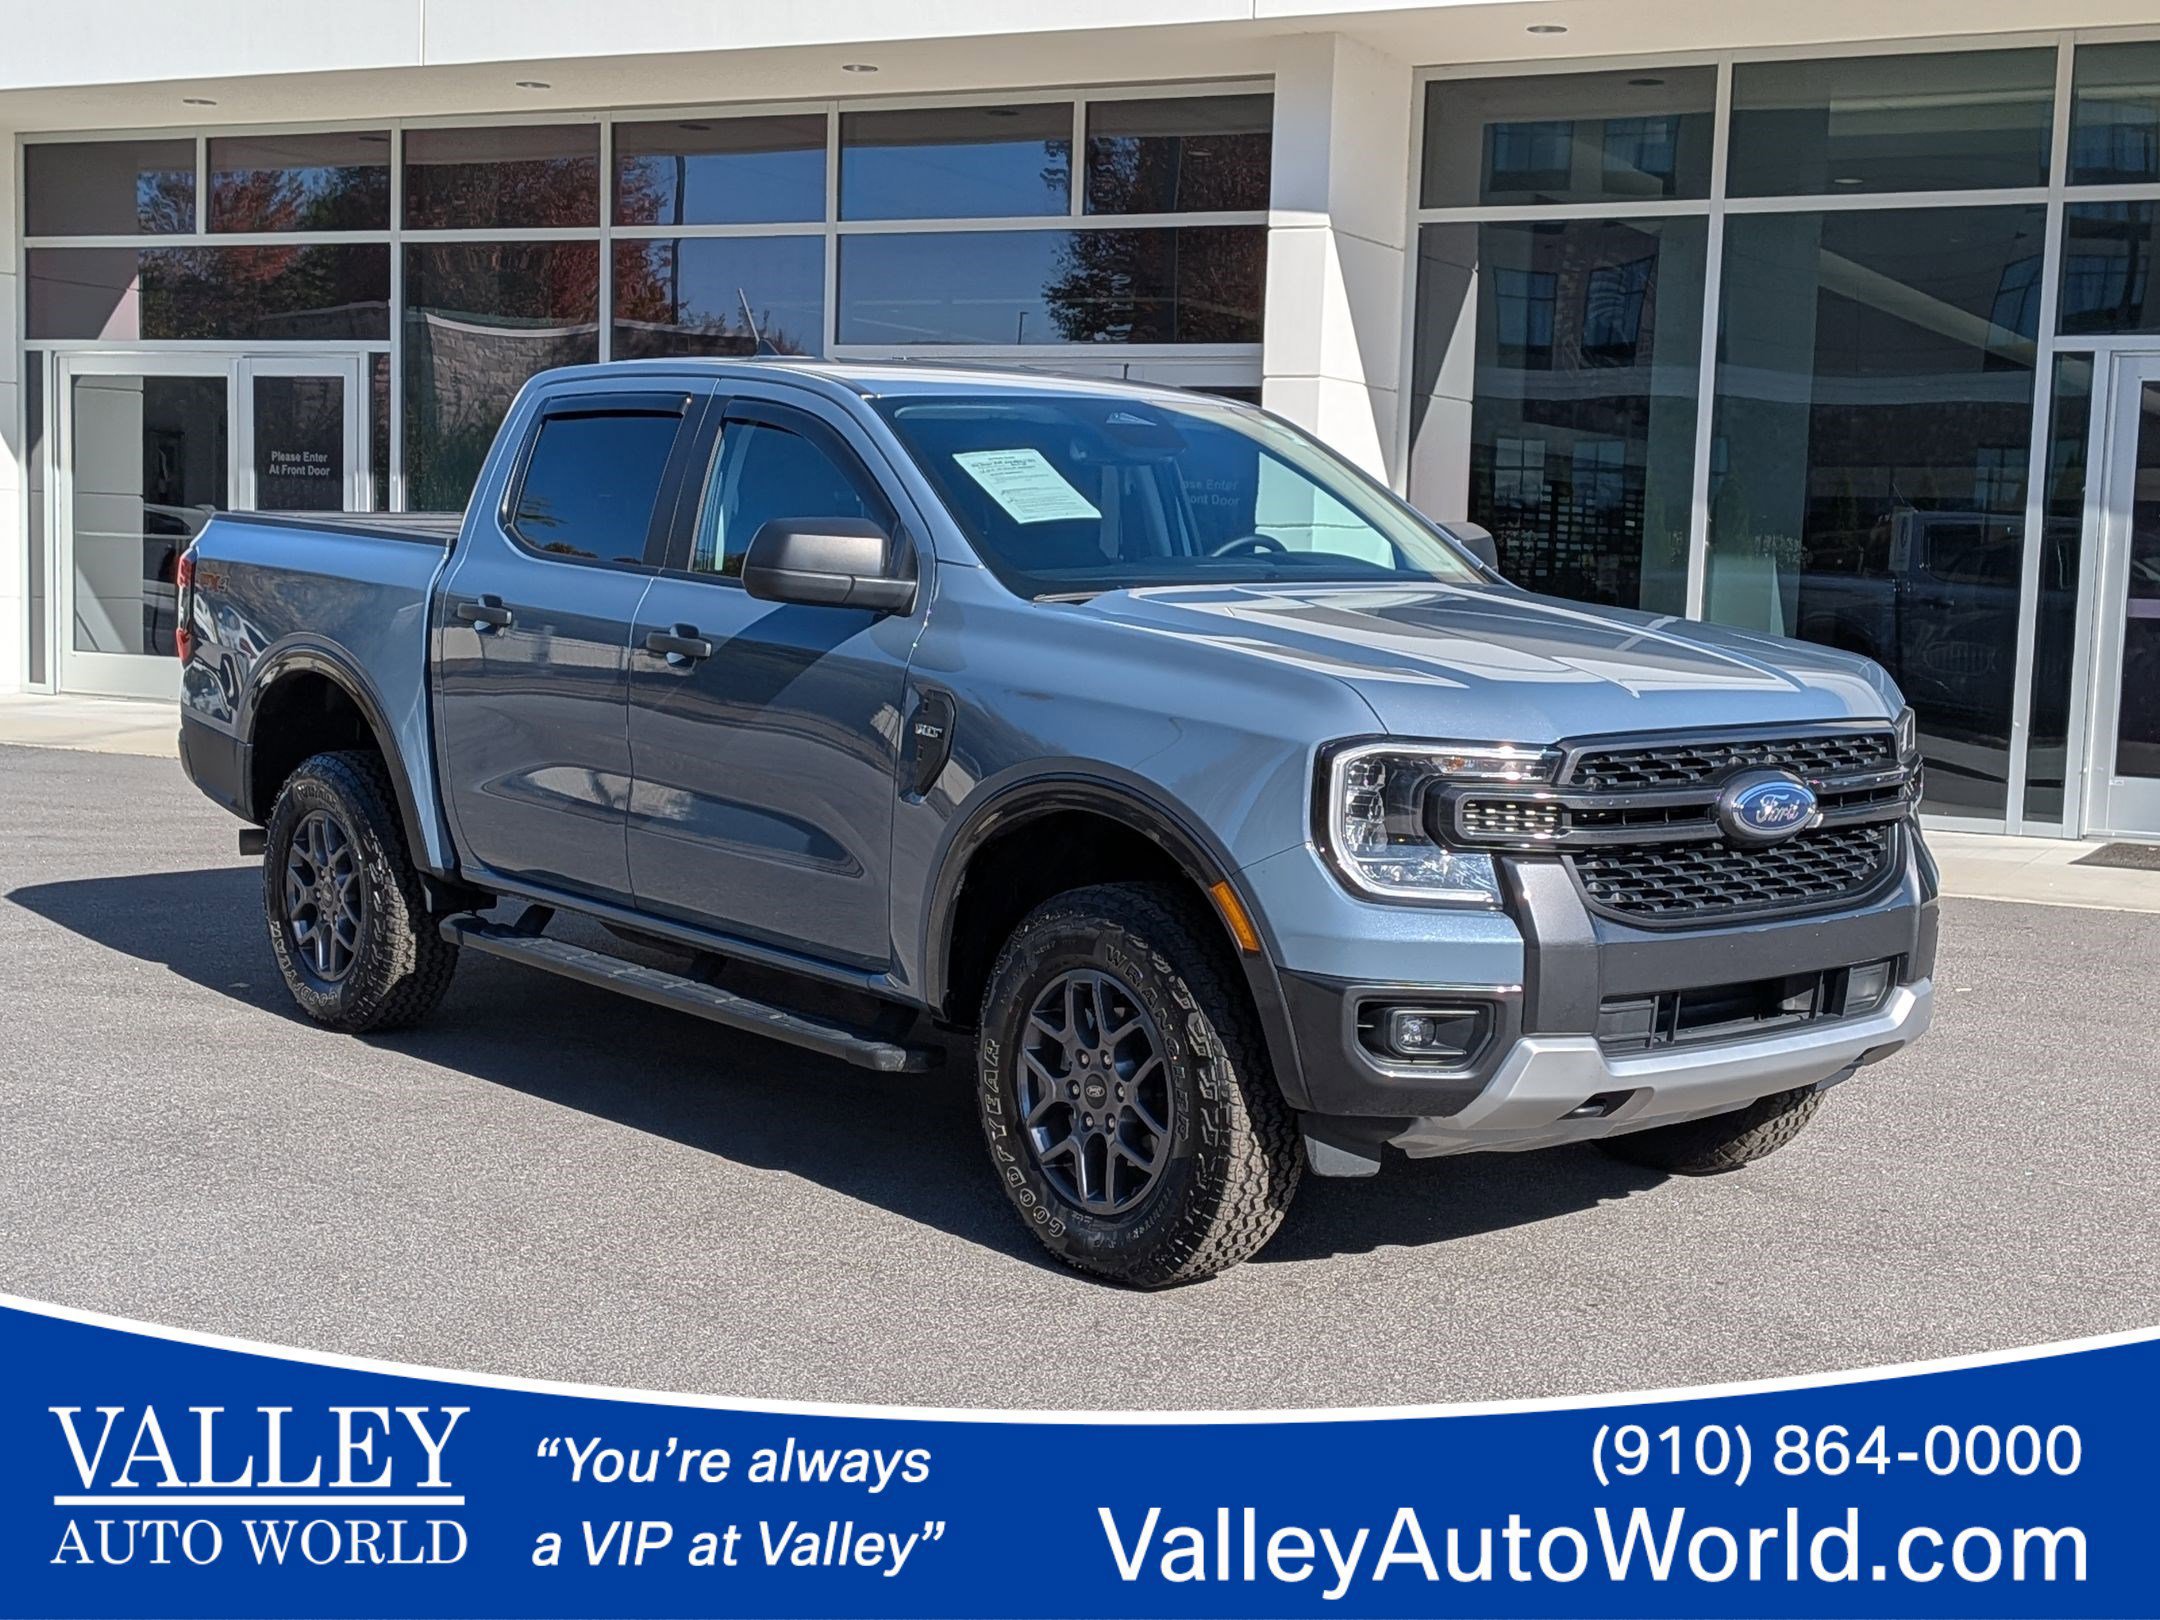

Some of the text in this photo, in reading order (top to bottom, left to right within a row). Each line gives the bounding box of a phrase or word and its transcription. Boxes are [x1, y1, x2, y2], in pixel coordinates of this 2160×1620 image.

[271, 451, 328, 462] Please Enter
[269, 464, 331, 476] At Front Door
[1190, 494, 1208, 505] ont
[1755, 794, 1801, 823] Ford
[984, 1038, 1066, 1238] GOODYEAR
